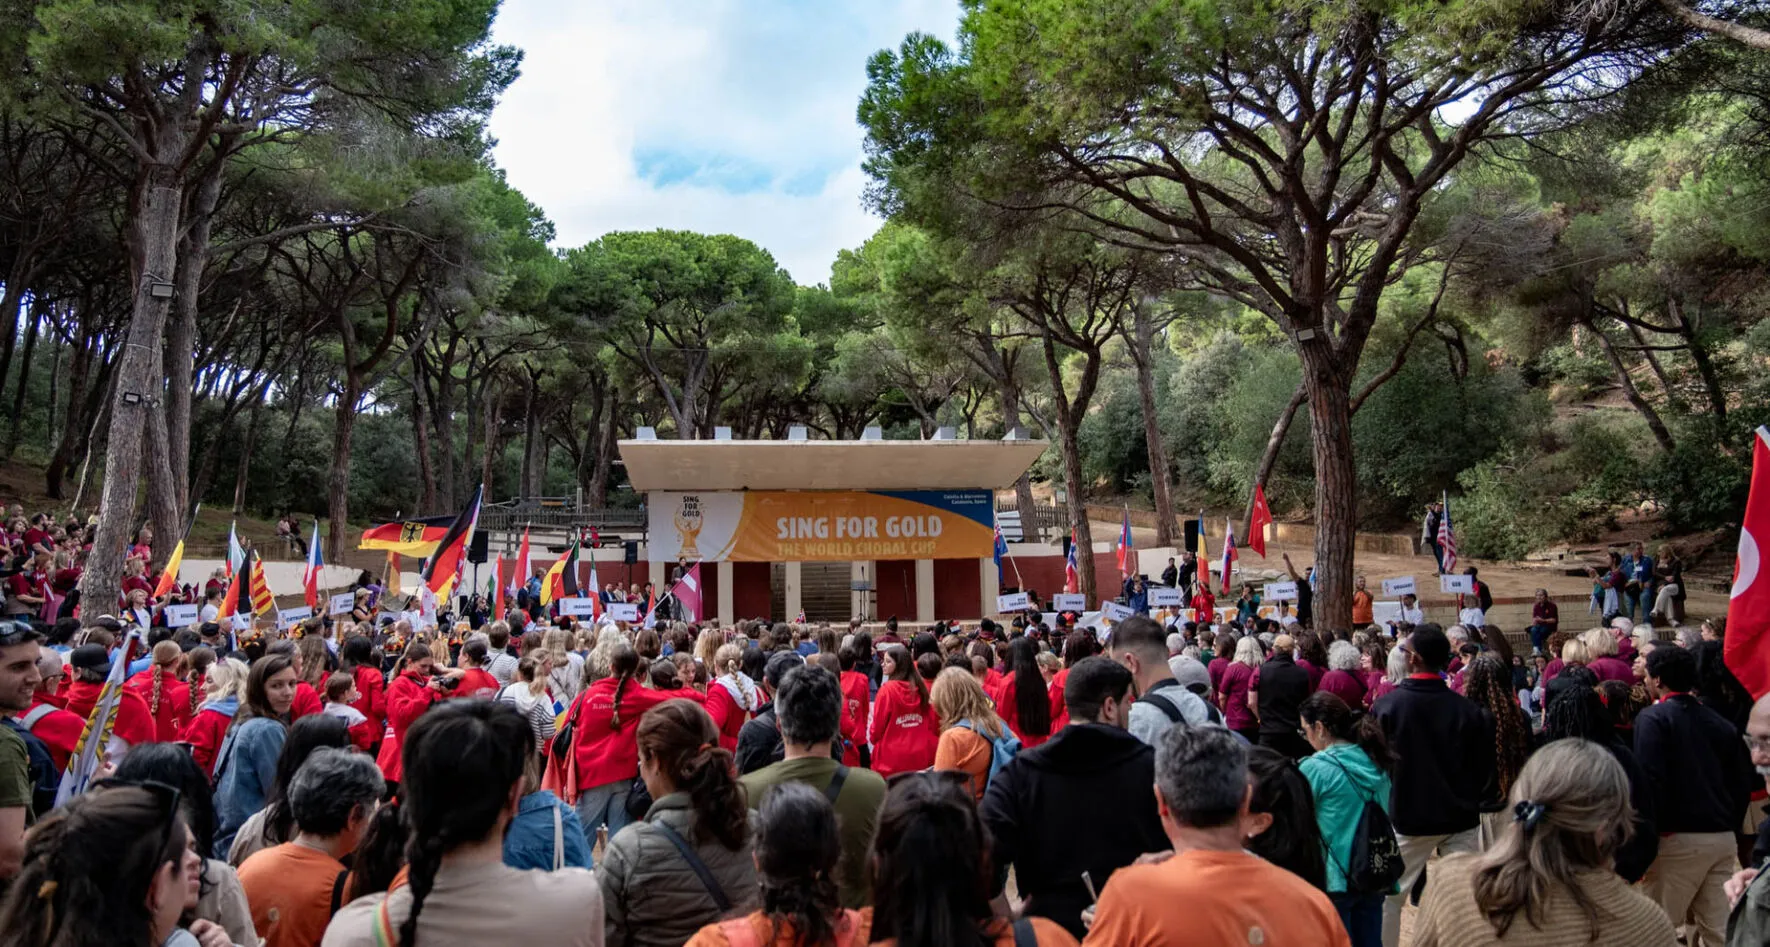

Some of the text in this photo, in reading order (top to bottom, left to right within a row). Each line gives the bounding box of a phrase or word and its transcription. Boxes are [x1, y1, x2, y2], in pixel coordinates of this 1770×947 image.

[776, 515, 943, 539] SING FOR GOLD
[777, 541, 936, 556] THE WORLD CHORAL CUP
